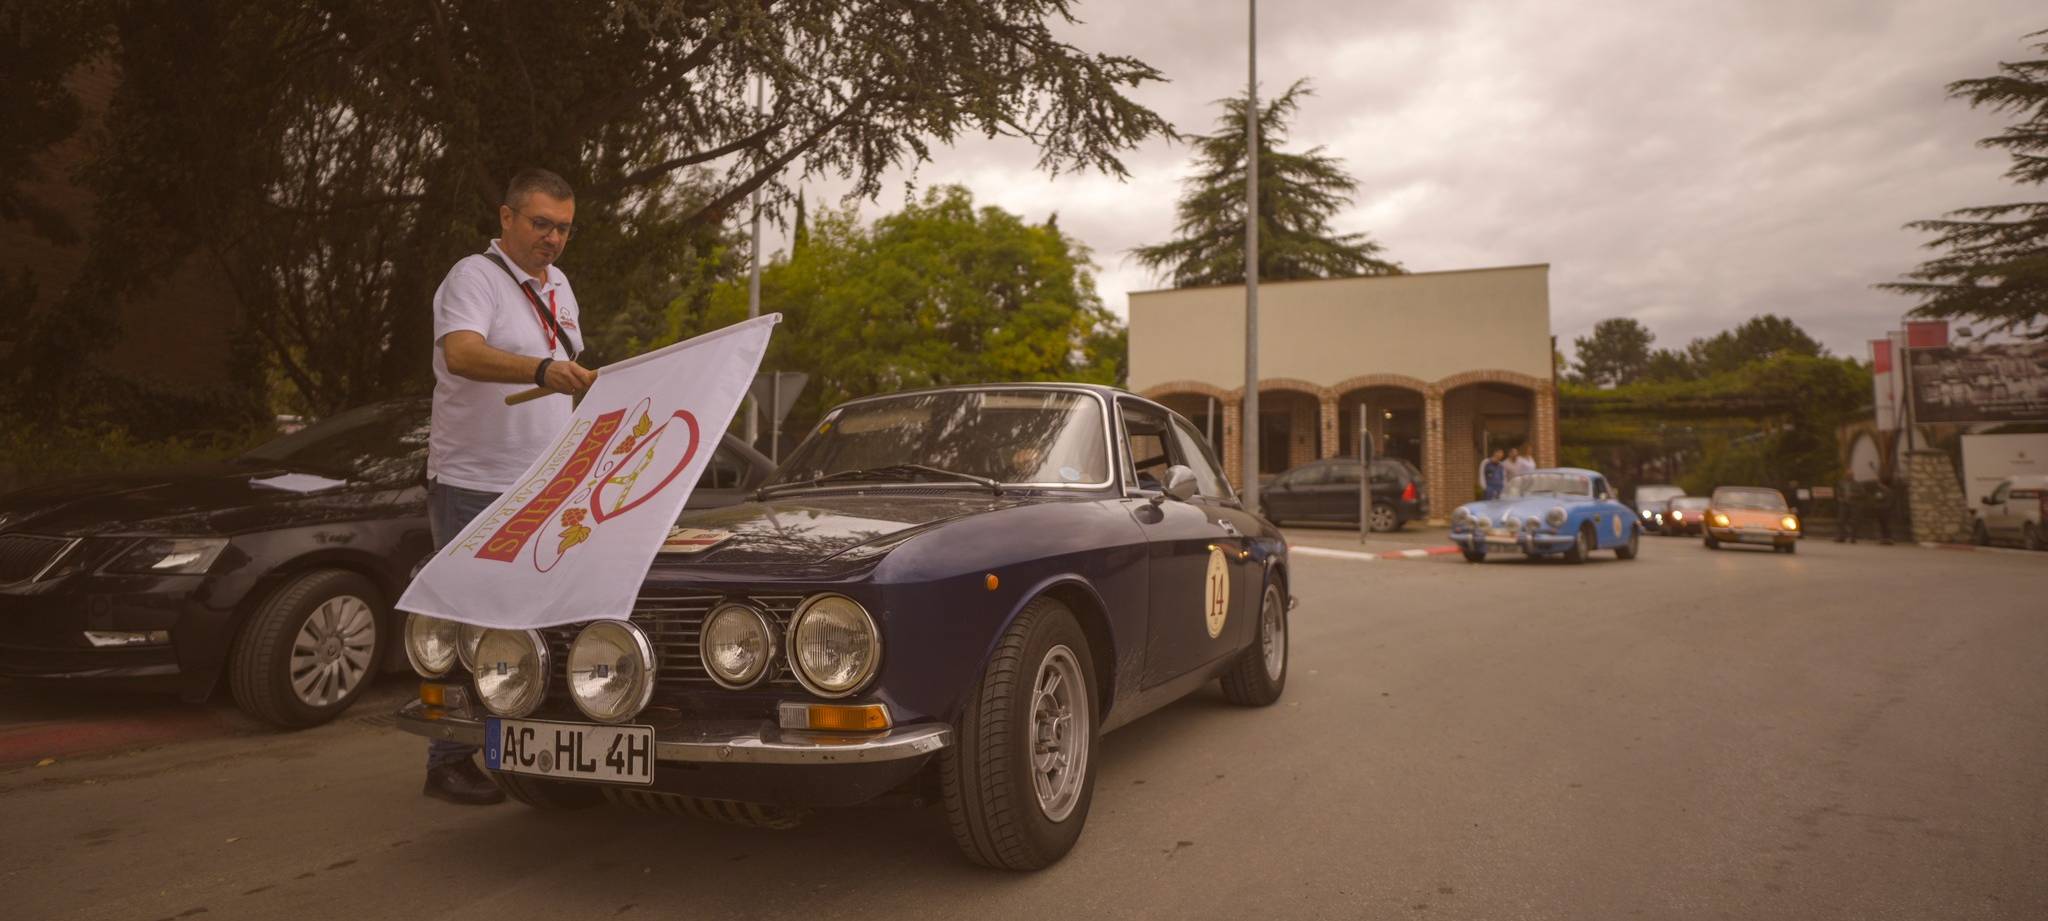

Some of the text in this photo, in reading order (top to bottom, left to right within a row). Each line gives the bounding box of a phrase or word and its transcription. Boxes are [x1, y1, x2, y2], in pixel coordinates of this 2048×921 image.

[463, 420, 592, 551] CLASSIC CAR RALLY
[488, 418, 620, 553] BACCHUS
[1210, 574, 1224, 616] 14
[490, 748, 497, 760] D
[502, 726, 649, 776] AC HL 4H
